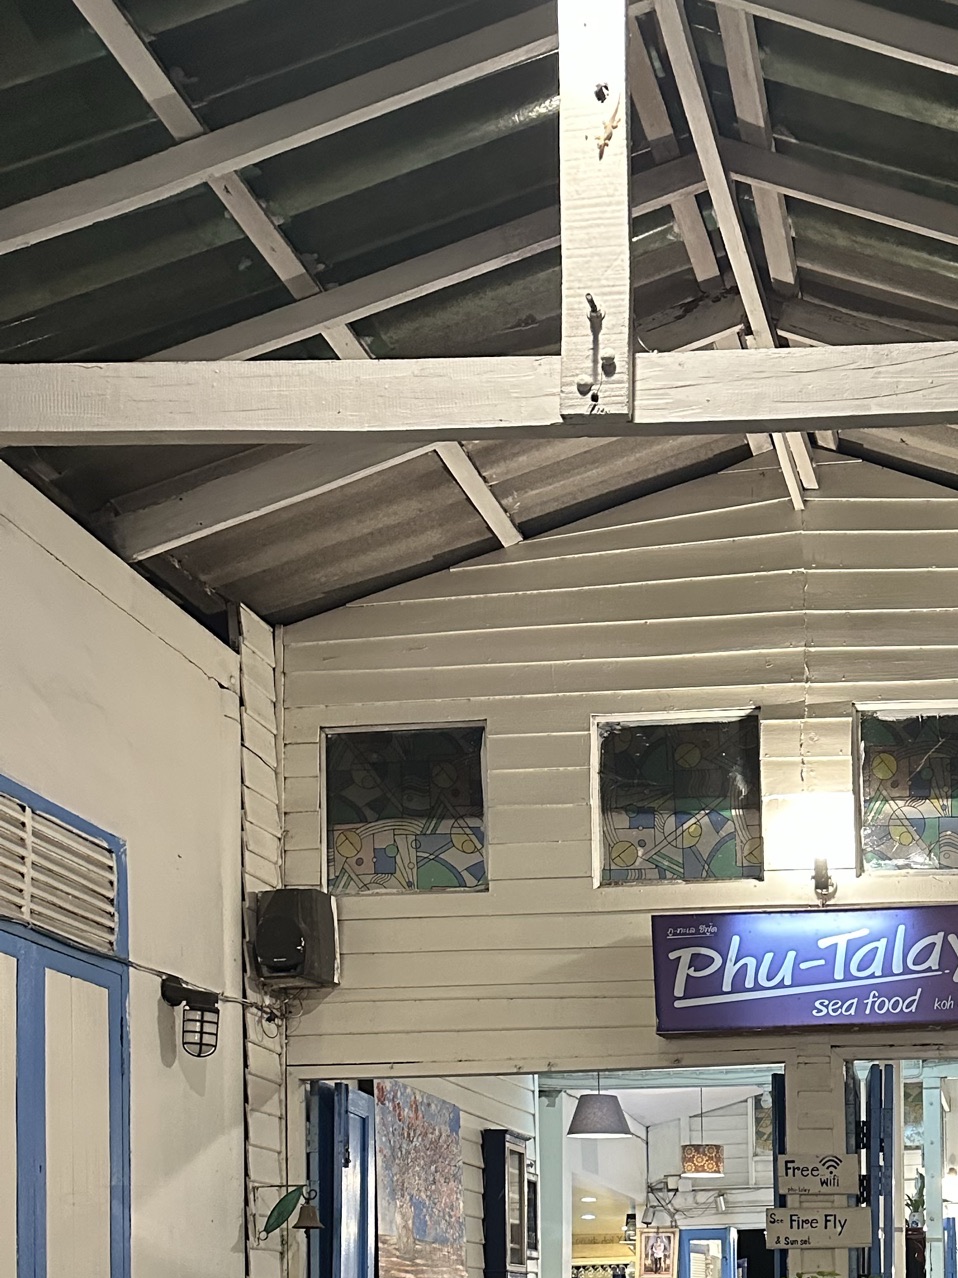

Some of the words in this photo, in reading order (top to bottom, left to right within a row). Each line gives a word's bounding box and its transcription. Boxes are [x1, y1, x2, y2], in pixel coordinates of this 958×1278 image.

[812, 996, 857, 1017] sea
[864, 988, 922, 1015] food
[933, 995, 954, 1011] koh
[784, 1160, 820, 1178] Free
[789, 1214, 819, 1230] Fire
[824, 1214, 848, 1236] Fly
